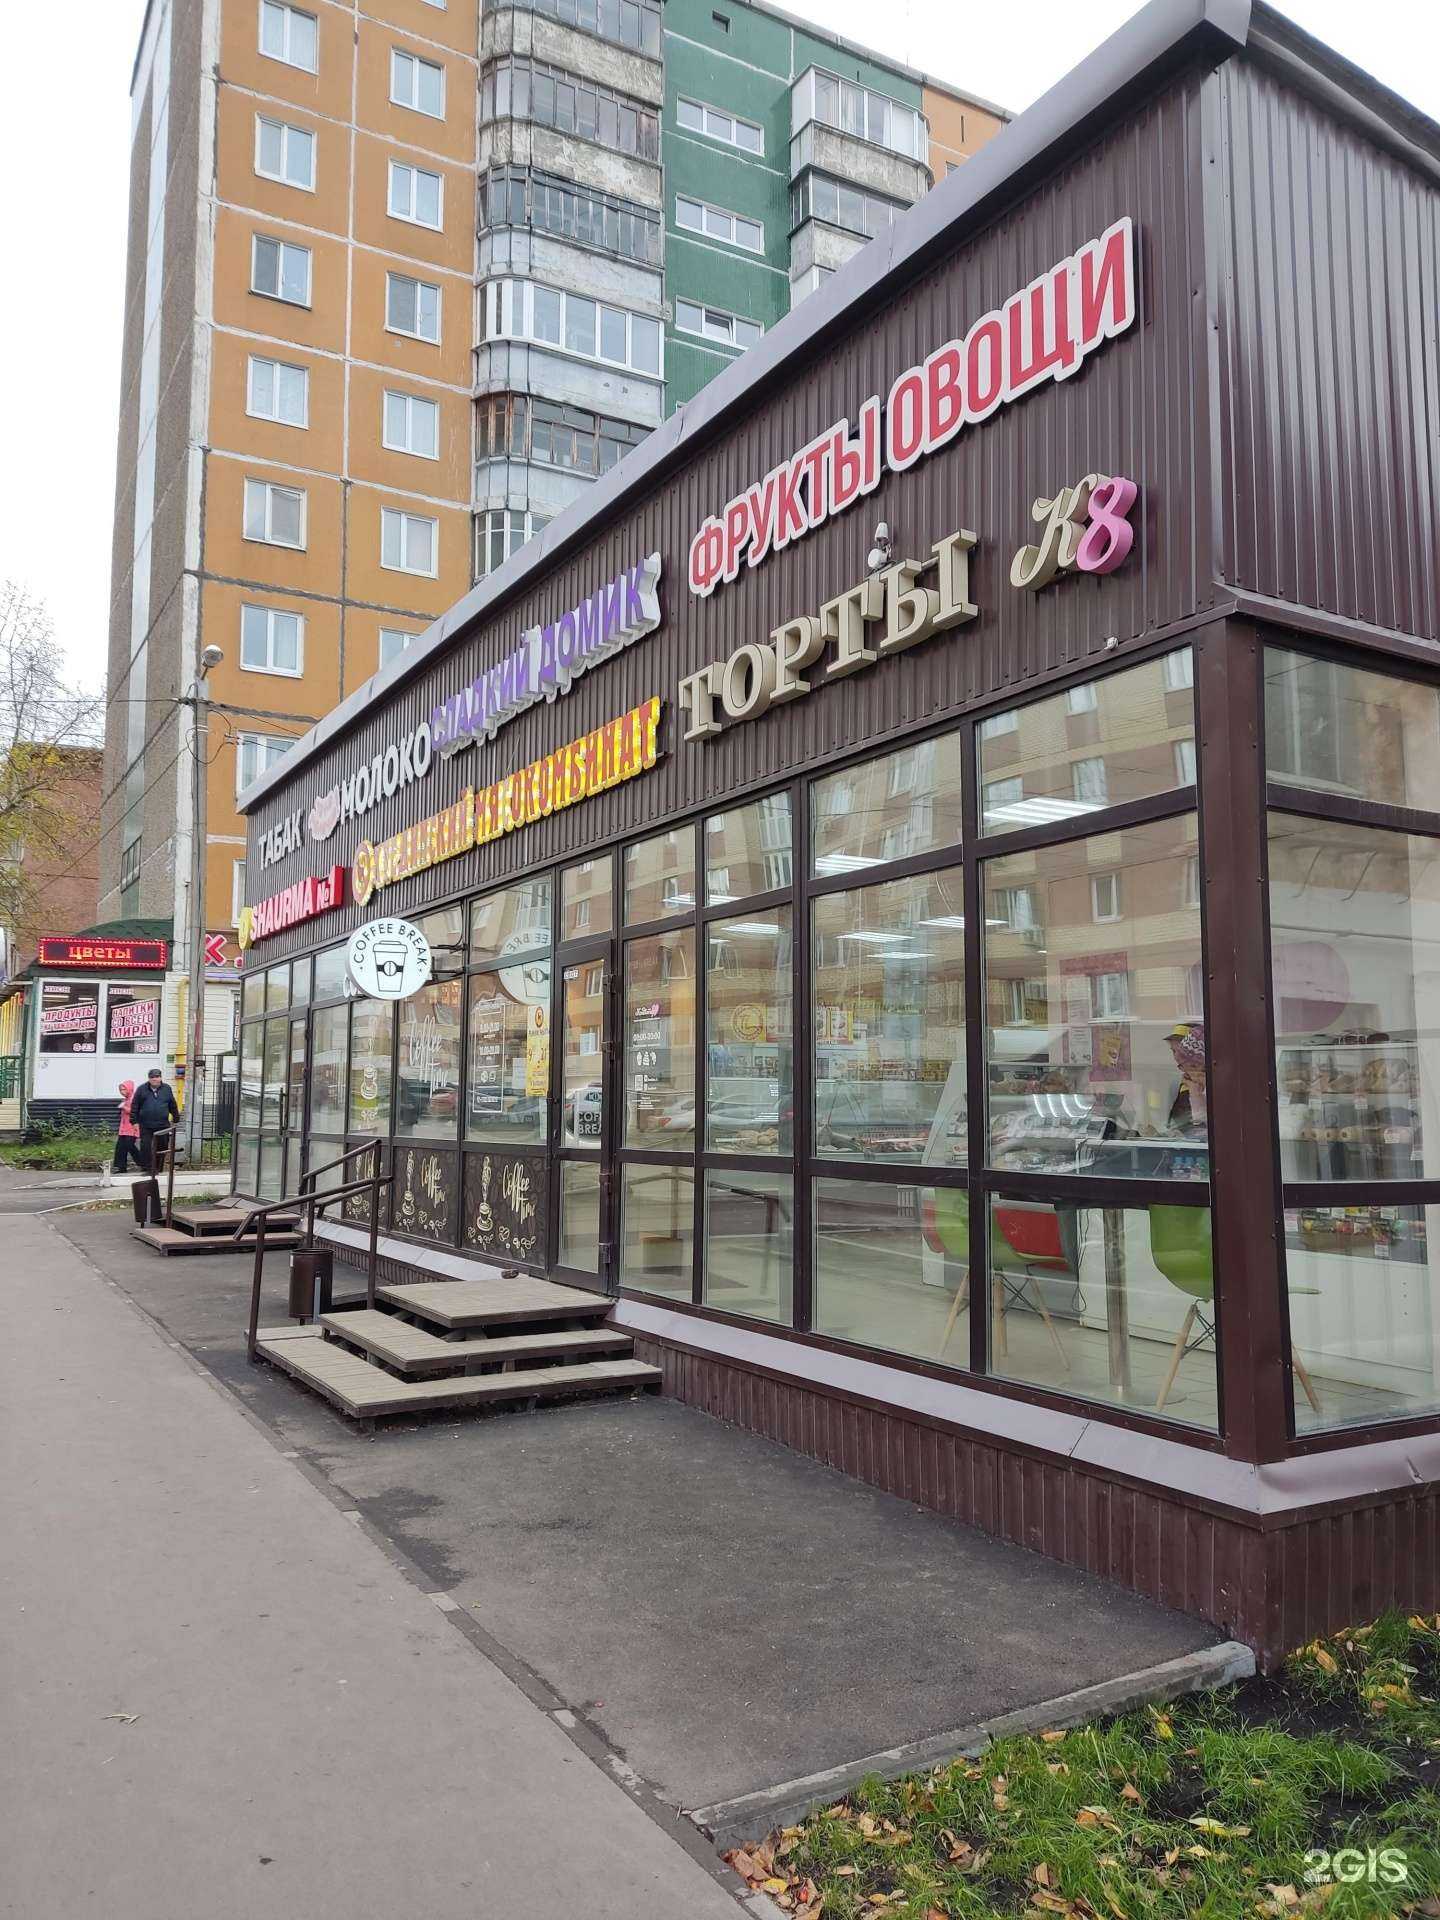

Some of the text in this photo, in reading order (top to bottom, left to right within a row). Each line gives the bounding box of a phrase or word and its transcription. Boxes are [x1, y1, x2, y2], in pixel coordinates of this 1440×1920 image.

[690, 219, 1132, 595] ФРУКТЫ ОВОЩИ
[432, 558, 657, 752] СЛАДКИЙ ДОМИК
[678, 528, 978, 742] ТОРТЫ
[341, 723, 431, 825] МОЛОКО
[476, 697, 660, 843] МЯСОКОМБИНАТ
[258, 810, 302, 870] ТАБАК
[251, 876, 316, 941] SHAURMA
[354, 924, 428, 967] COFFEE BREAK
[45, 1004, 97, 1021] ПРОДУКТЫ
[111, 1002, 154, 1018] НАПИТКИ
[111, 1023, 153, 1039] МИРА!
[124, 1013, 153, 1025] ВСЕГО
[502, 1162, 530, 1213] Coffee
